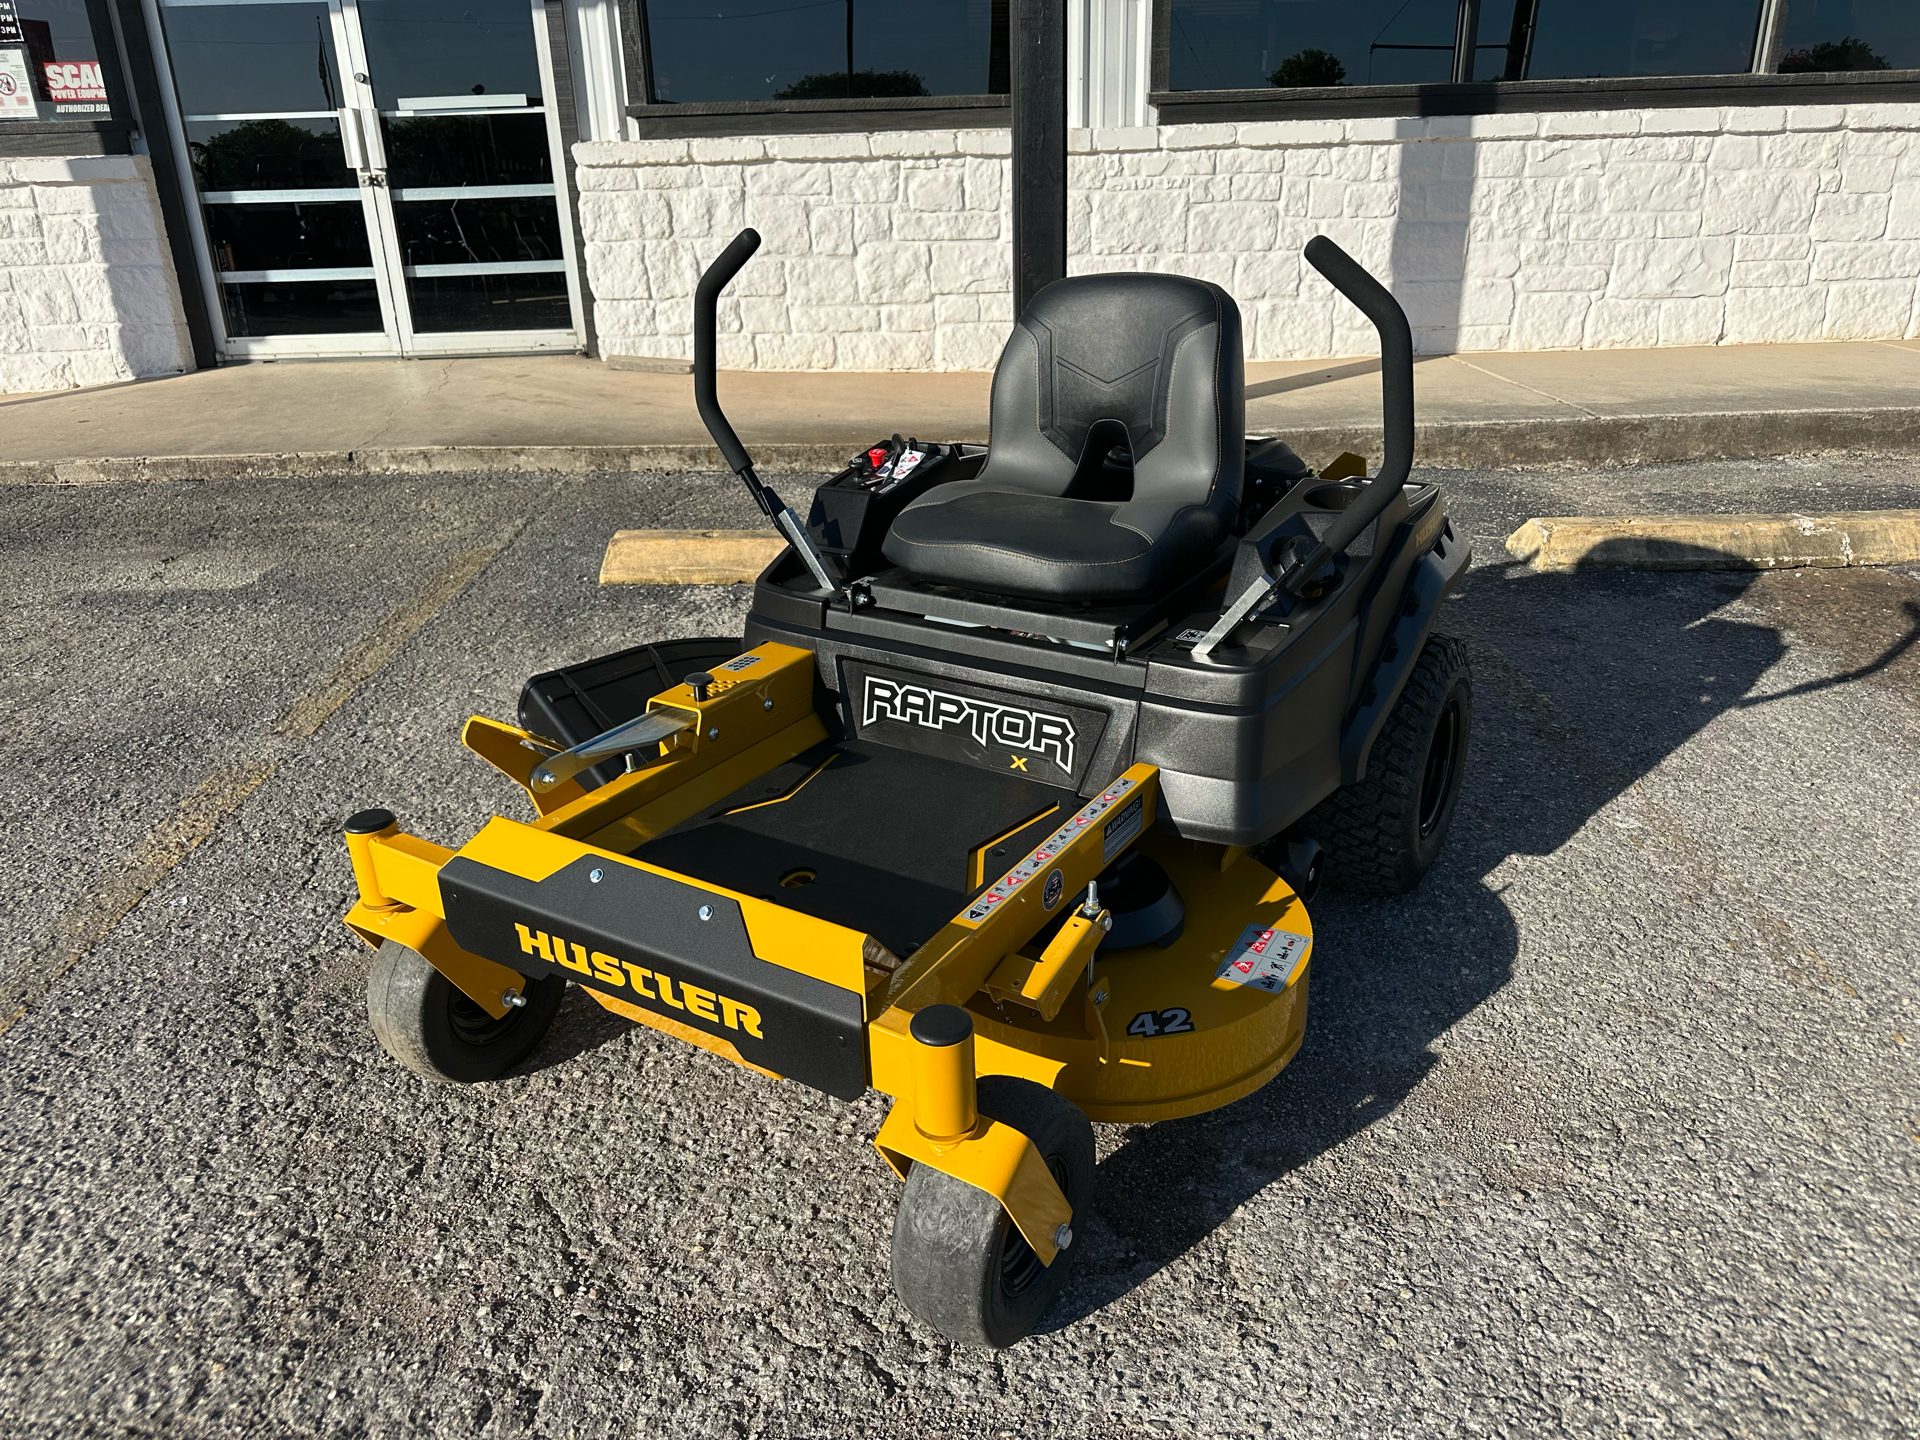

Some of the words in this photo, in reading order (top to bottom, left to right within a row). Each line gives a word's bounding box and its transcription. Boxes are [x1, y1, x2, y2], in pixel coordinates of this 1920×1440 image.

[51, 90, 76, 99] POWER
[56, 104, 94, 113] AUTHORIZED
[863, 676, 1076, 775] RAPTOR
[1010, 755, 1028, 771] X
[1111, 797, 1142, 832] WARNING!
[514, 922, 764, 1039] HUSTLER
[1129, 1008, 1192, 1036] 42
